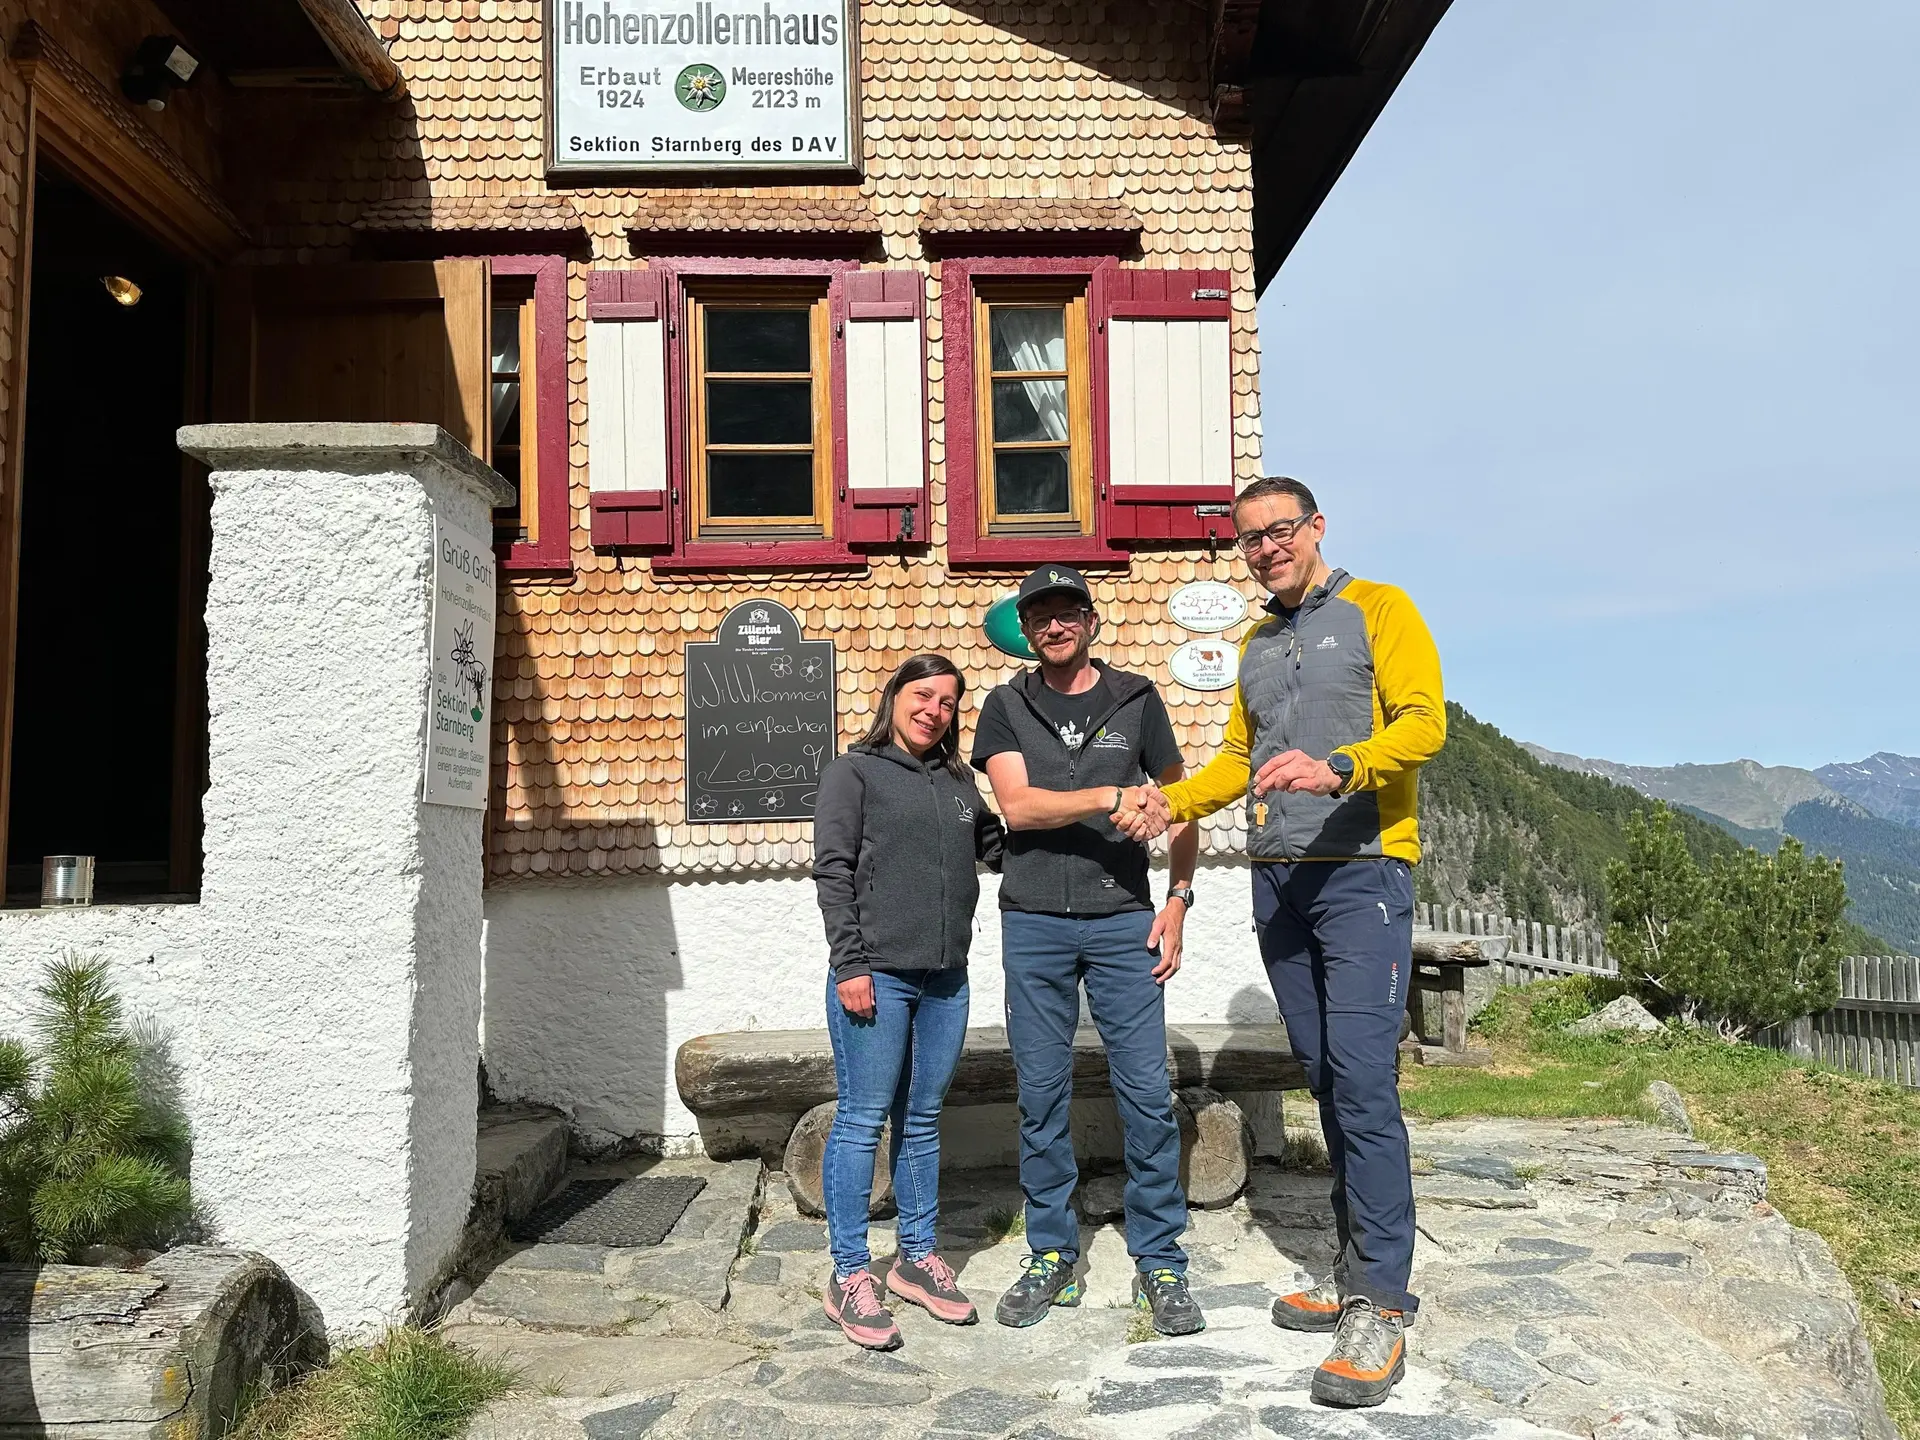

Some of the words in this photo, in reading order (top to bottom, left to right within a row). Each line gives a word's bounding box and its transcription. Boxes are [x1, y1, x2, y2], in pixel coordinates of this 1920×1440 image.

[563, 1, 839, 46] Hohenzollernhaus
[580, 66, 662, 87] Erbaut
[732, 66, 834, 87] Meereshöhe
[597, 90, 645, 109] 1924
[751, 90, 799, 109] 2123
[805, 95, 821, 109] m
[569, 136, 640, 152] Sektion
[651, 136, 741, 155] Starnberg
[751, 136, 782, 152] des
[791, 136, 837, 152] DAV
[442, 538, 470, 575] Grüß
[472, 555, 492, 589] Gott
[465, 583, 475, 595] am
[441, 584, 492, 624] Hohenzollernhaus
[737, 624, 782, 635] Zillertal
[747, 635, 772, 645] Bier
[438, 672, 447, 684] die
[689, 662, 827, 709] Willkommen
[437, 689, 468, 715] Sektion
[436, 712, 474, 743] Starnberg
[701, 724, 728, 739] im
[736, 715, 828, 743] einfachen
[435, 743, 459, 758] wünscht
[458, 748, 469, 761] allen
[437, 761, 452, 774] einen
[453, 765, 482, 777] angenehmen
[447, 777, 473, 791] Aufenthalt
[1388, 970, 1399, 1004] STELLAR
